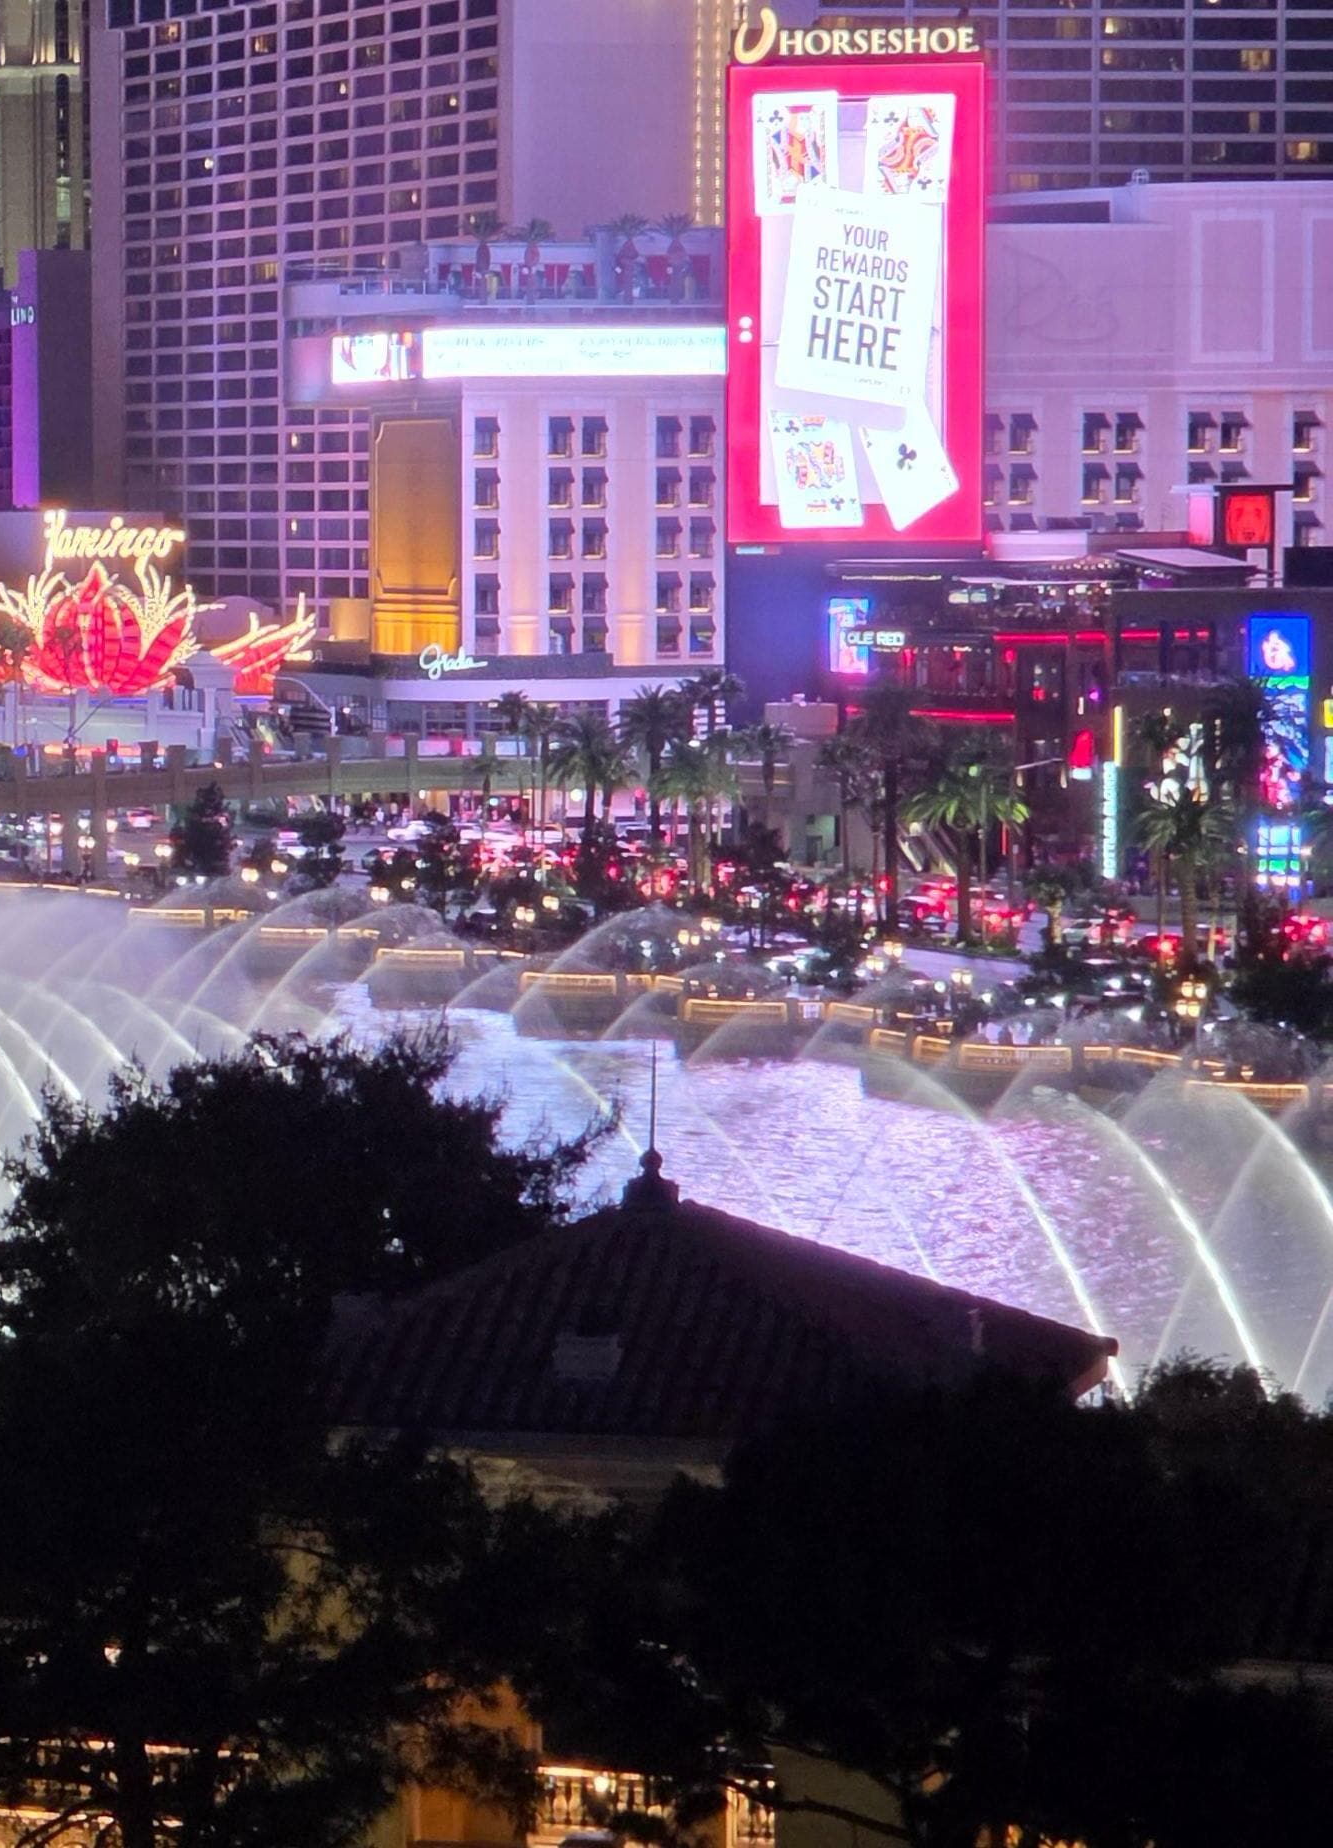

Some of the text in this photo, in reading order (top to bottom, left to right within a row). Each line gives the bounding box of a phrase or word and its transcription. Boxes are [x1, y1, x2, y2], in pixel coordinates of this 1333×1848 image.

[779, 27, 974, 55] HORSESHOE
[843, 224, 889, 251] YOUR
[816, 246, 909, 283] REWARDS
[813, 275, 906, 322] START
[807, 314, 901, 371] HERE
[43, 508, 186, 578] Flamingo
[847, 631, 905, 646] OLE RED
[419, 643, 489, 681] Giada
